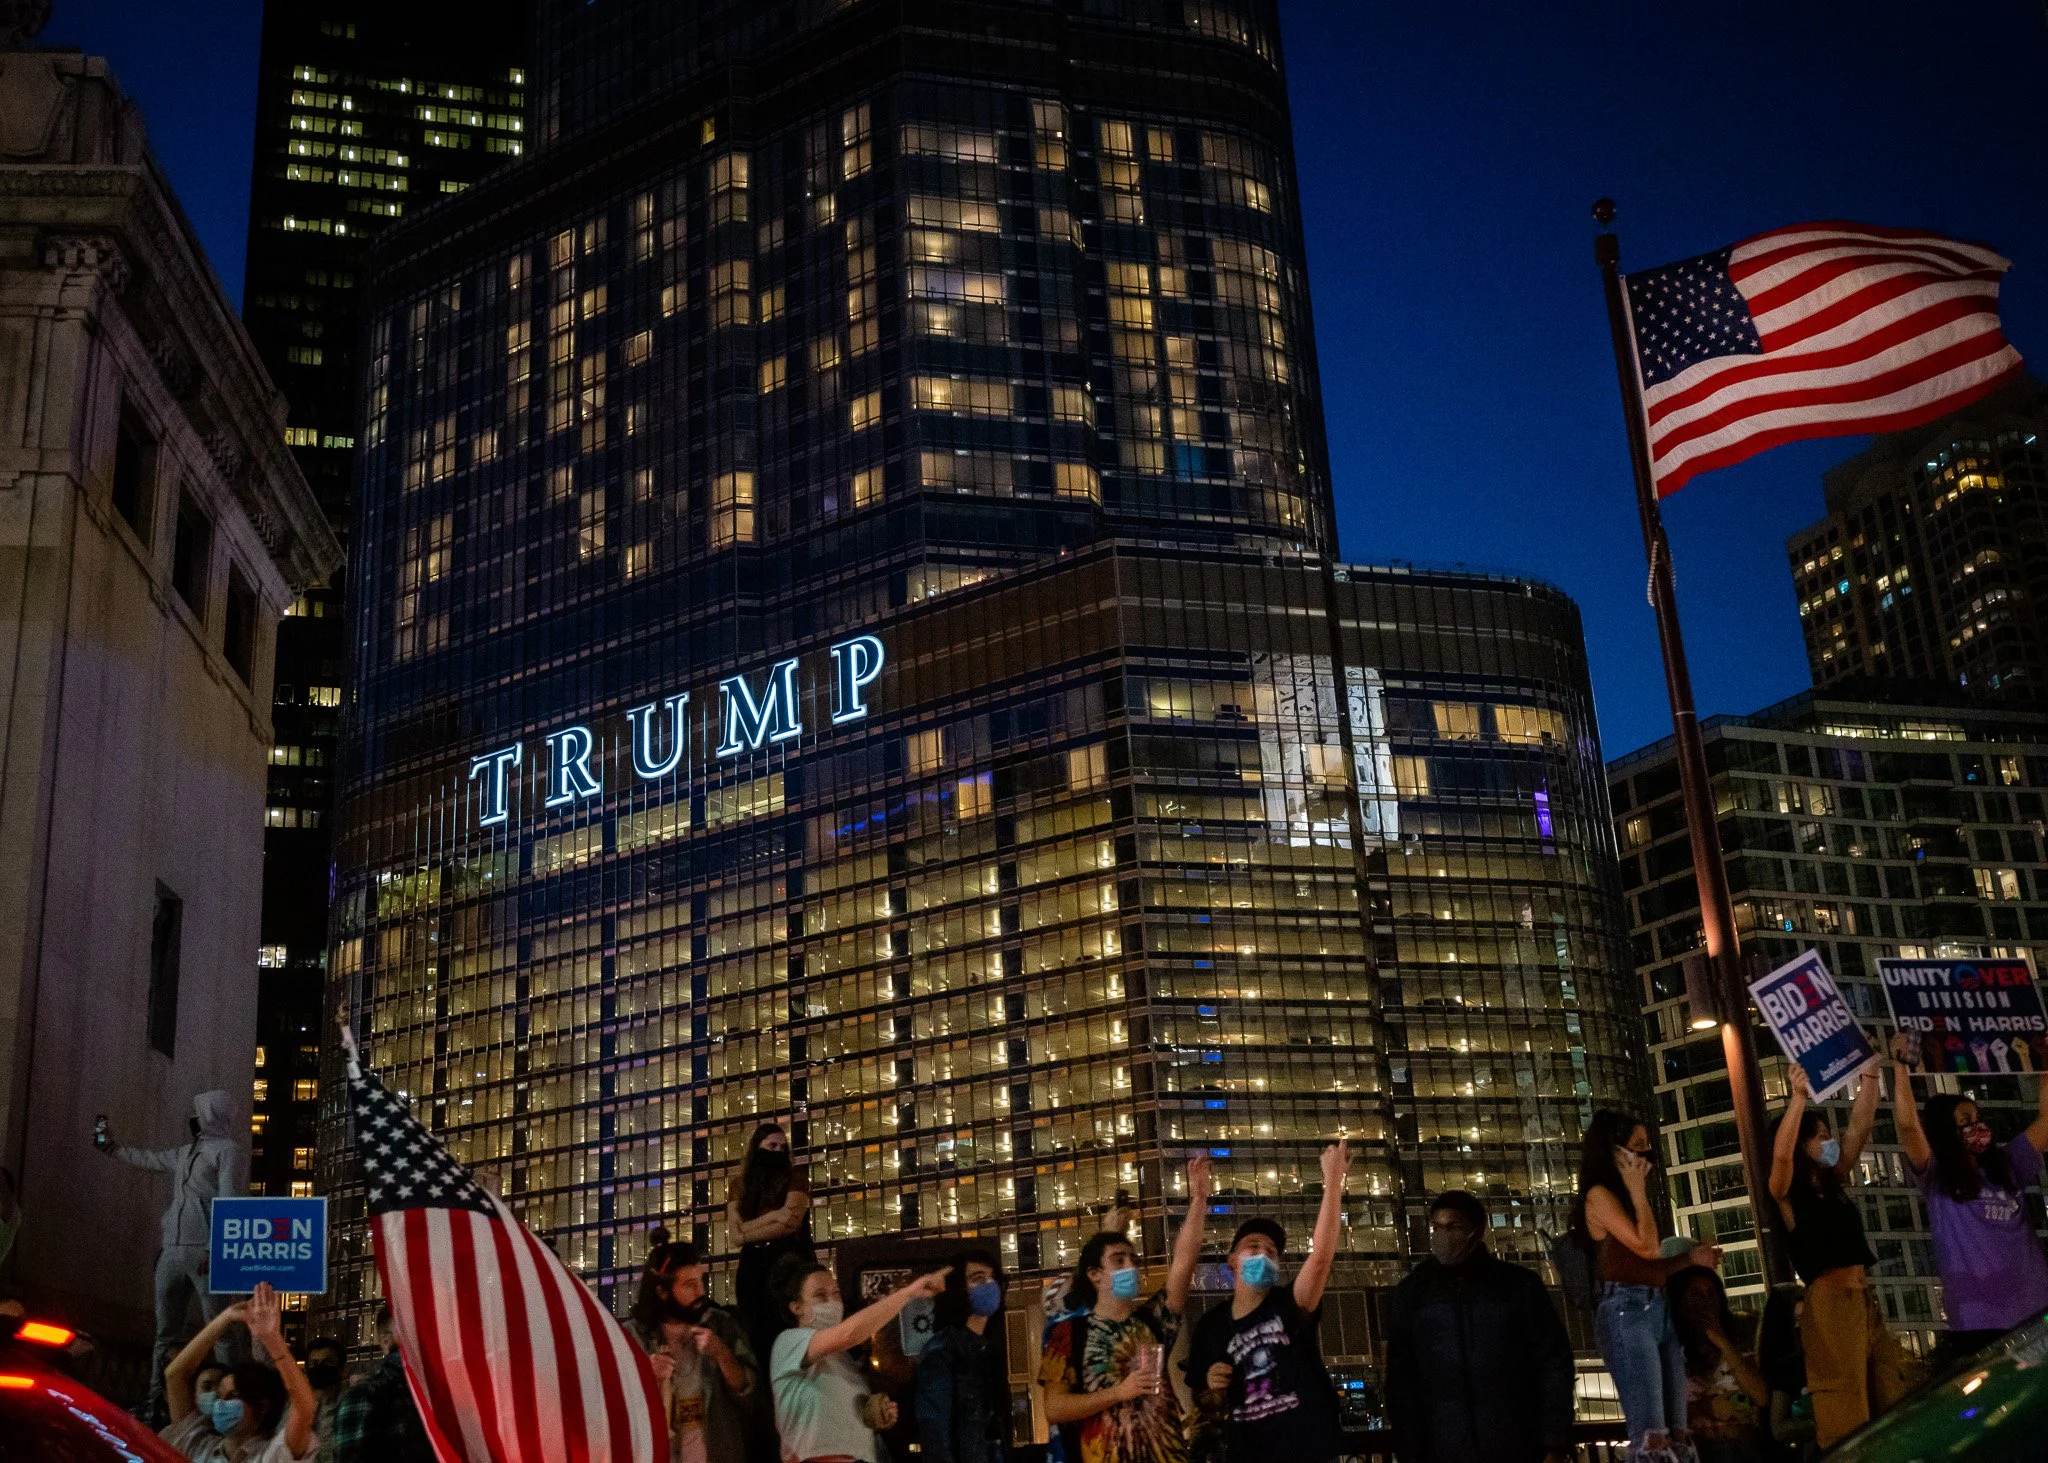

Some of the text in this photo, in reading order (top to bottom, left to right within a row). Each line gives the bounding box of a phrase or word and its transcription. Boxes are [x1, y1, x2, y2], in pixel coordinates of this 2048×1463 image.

[469, 635, 885, 826] TRUMP
[1883, 964, 2031, 990] UNITY OVER
[1762, 965, 1835, 1029] BIDEN
[1917, 990, 2011, 1009] DIVISION
[1782, 1000, 1850, 1058] HARRIS
[1899, 1014, 2046, 1032] BIDEN HARRIS
[223, 1218, 312, 1240] BIDEN
[222, 1242, 312, 1260] HARRIS
